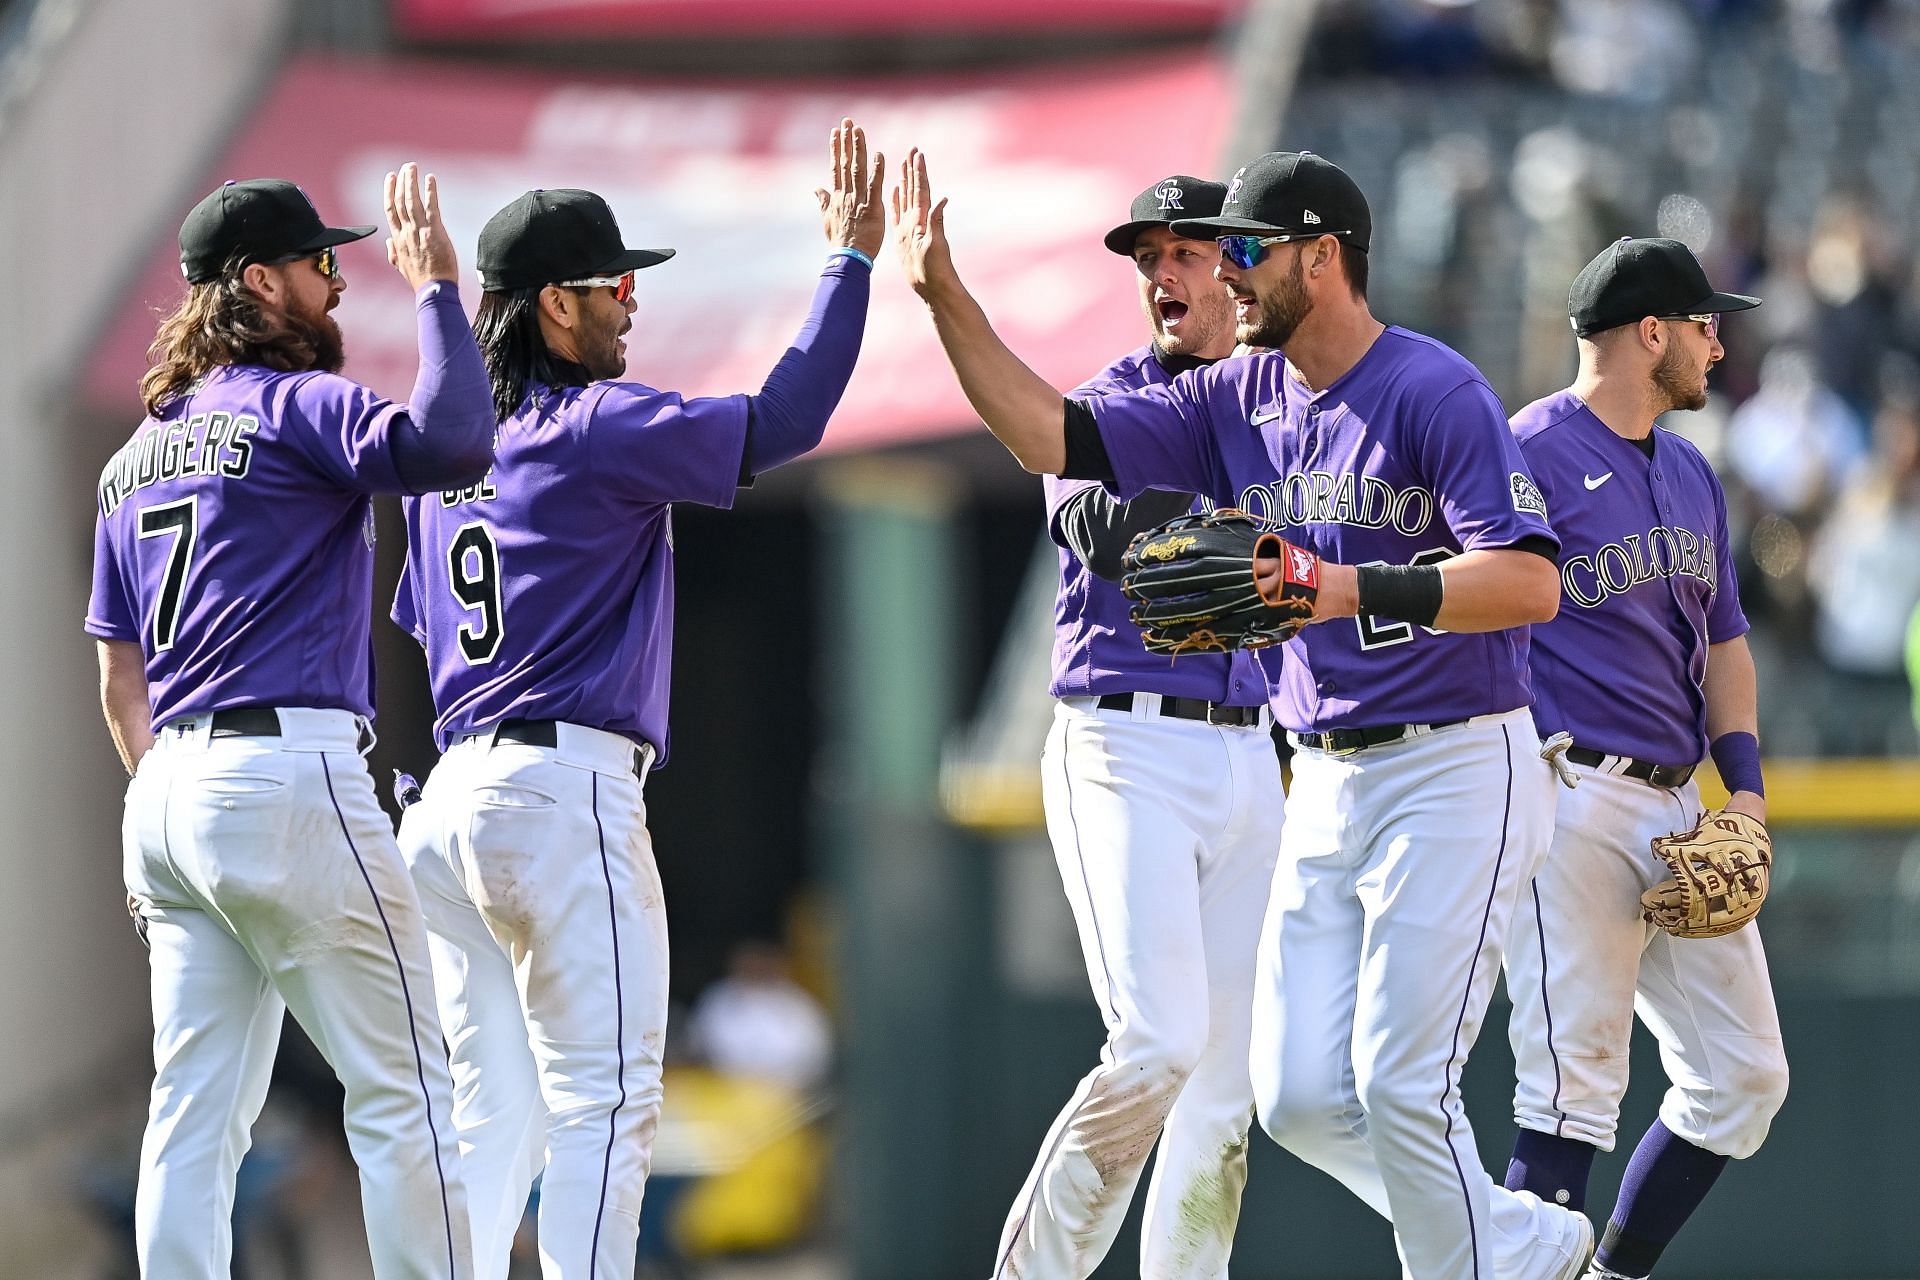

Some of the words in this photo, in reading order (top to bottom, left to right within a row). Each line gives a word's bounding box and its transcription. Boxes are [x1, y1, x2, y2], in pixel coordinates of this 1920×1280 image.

[97, 410, 260, 520] RODGERS
[1239, 470, 1434, 537] OLORADO
[138, 493, 198, 653] 7
[446, 520, 504, 667] 9
